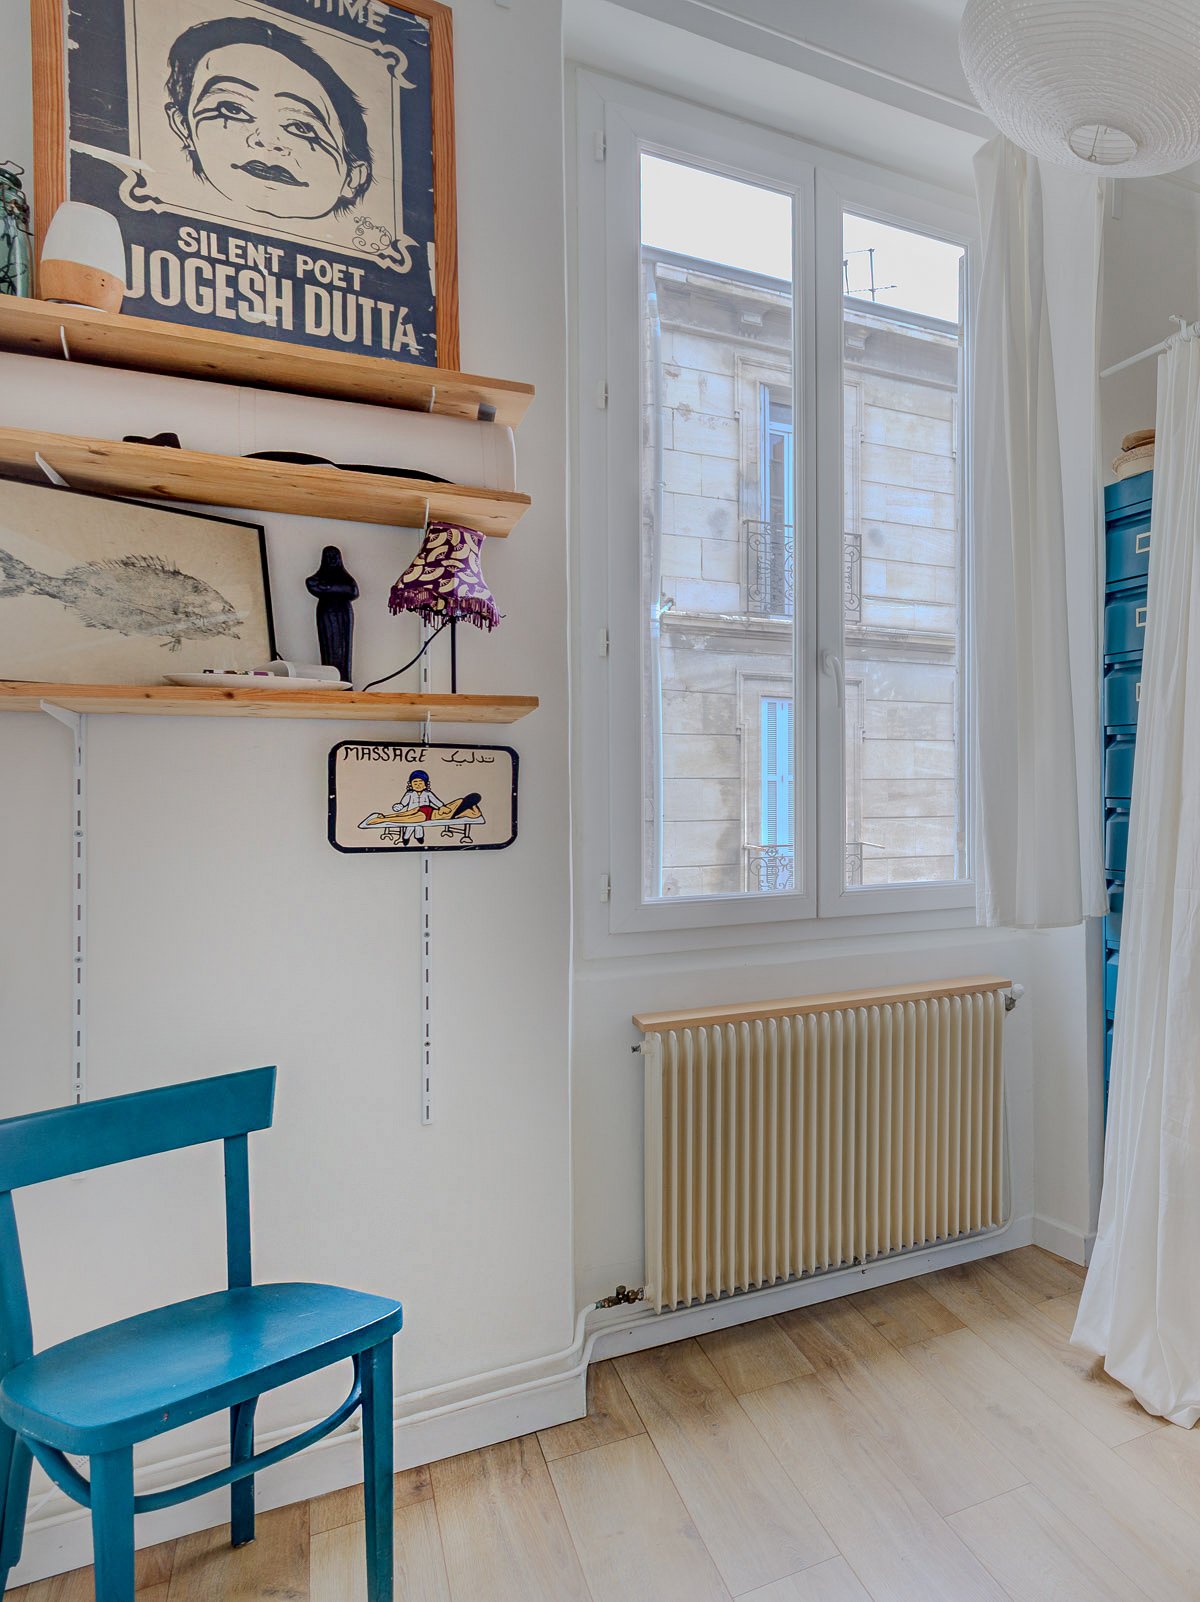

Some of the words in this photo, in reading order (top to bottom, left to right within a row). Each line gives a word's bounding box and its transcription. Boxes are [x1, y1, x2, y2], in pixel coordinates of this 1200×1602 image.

[178, 226, 284, 273] SILENT
[296, 254, 365, 291] POET
[123, 244, 293, 331] JOGESH
[304, 284, 420, 355] DUTTA
[343, 746, 428, 763] MASSAGE
